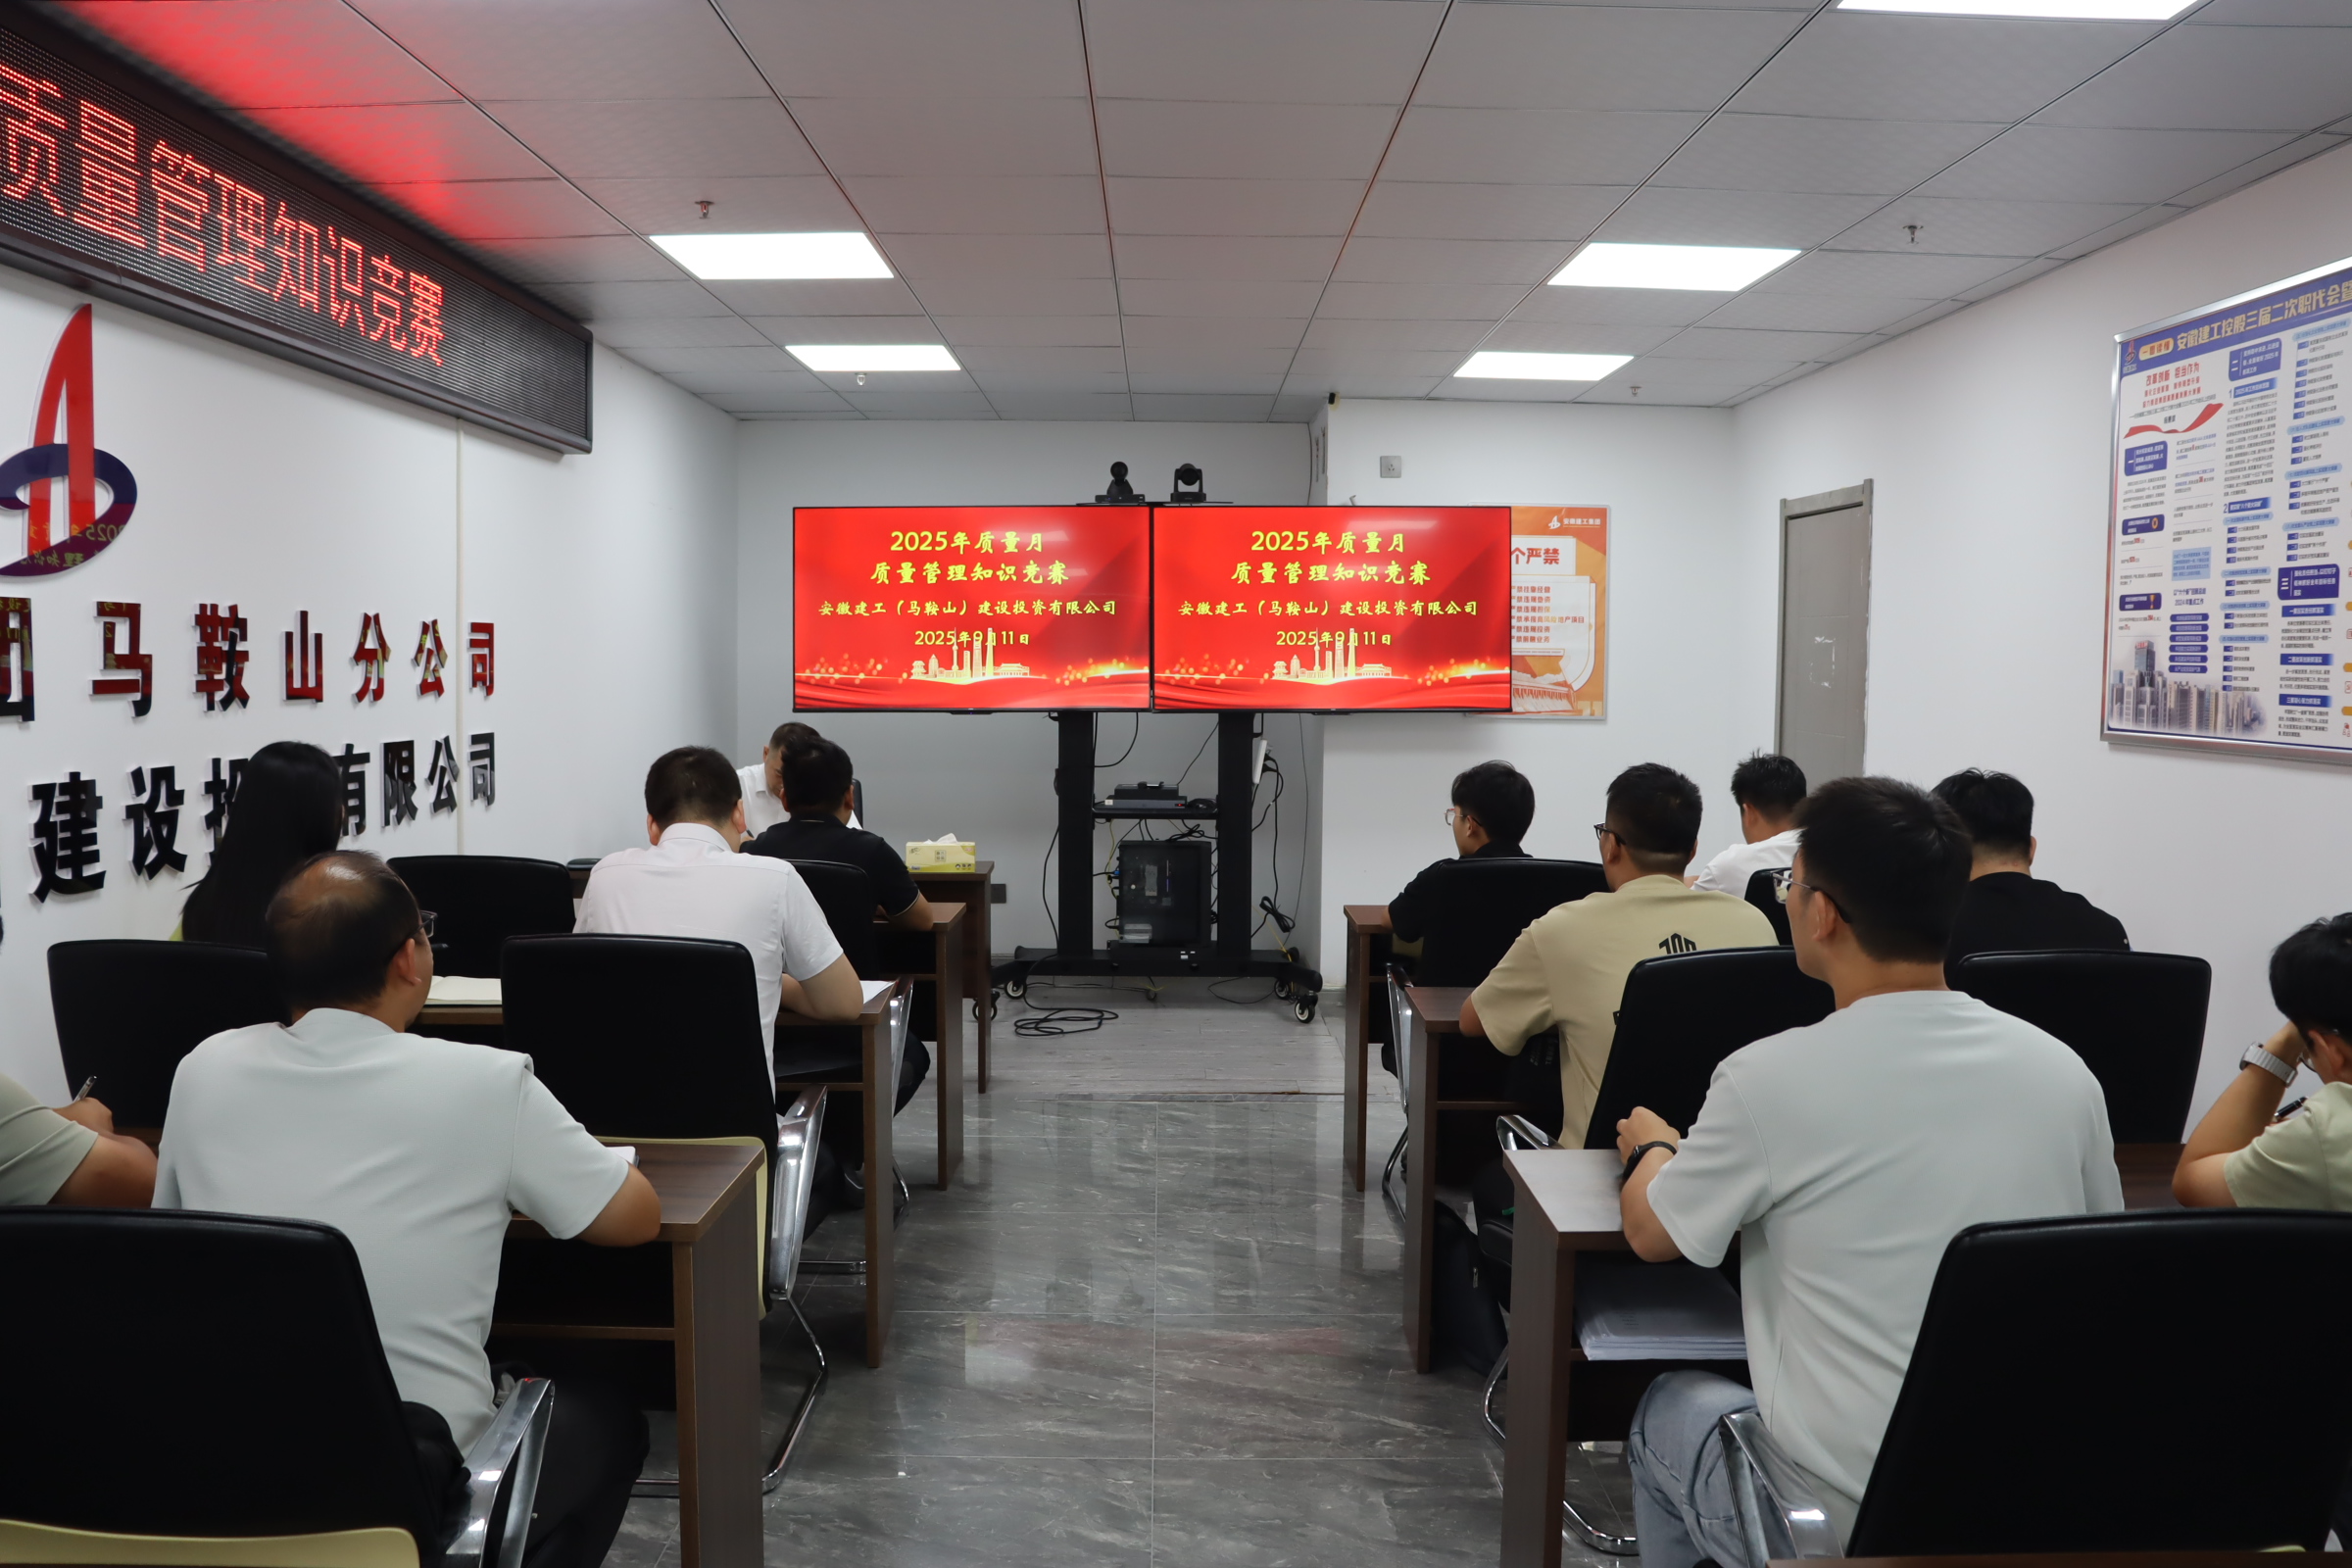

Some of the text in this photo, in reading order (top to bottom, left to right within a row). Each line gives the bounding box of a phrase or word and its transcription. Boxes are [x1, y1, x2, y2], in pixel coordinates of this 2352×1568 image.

[0, 64, 445, 367] 质量管理知识竞赛
[890, 530, 1043, 555] 2025年质量月
[1251, 530, 1404, 555] 2025年质量月
[1511, 547, 1560, 565] 个严禁
[870, 560, 1069, 585] 质量管理知识竞赛
[1231, 560, 1431, 585] 质量管理知识竞赛
[818, 599, 1116, 616] 安徽建工（马鞍山）建设投资有限公司
[1178, 599, 1478, 616] 安徽建工（马鞍山）建设投资有限公司
[29, 731, 496, 904] 建设有限公司
